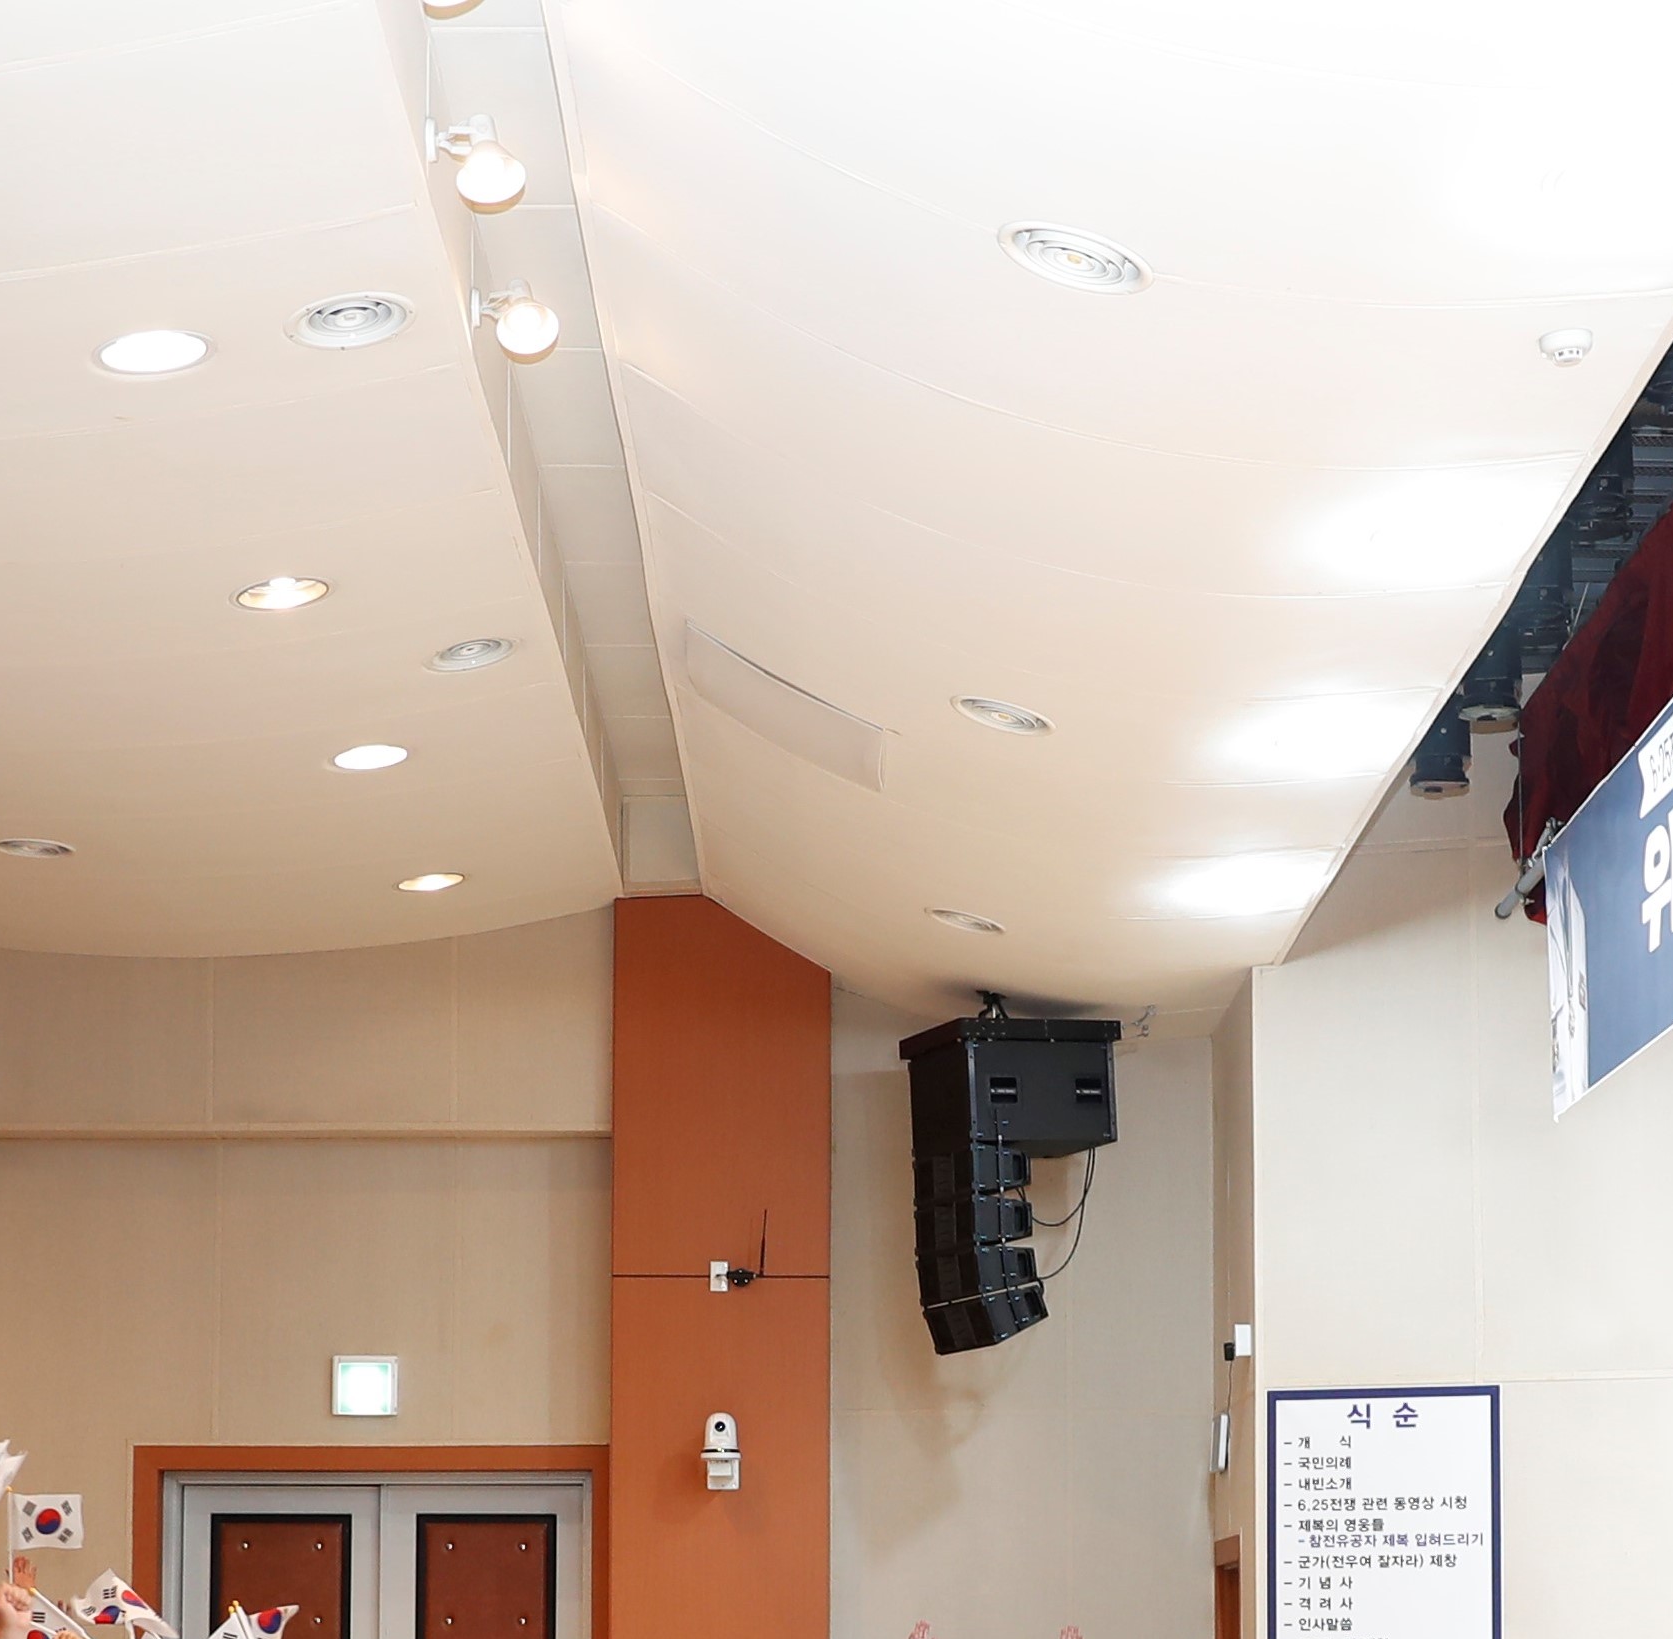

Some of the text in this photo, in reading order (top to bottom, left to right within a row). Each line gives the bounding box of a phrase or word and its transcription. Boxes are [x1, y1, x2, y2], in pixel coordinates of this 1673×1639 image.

[1298, 1457, 1351, 1470] 국민의례
[1299, 1477, 1351, 1490] 내빈소개
[1362, 1498, 1387, 1510] 관련
[1394, 1497, 1434, 1510] 동영상
[1441, 1496, 1466, 1509] 시청
[1299, 1518, 1384, 1532] 제복의 영웅들
[1309, 1533, 1483, 1548] 참전유공자 제복 입혀드리기
[1298, 1554, 1457, 1569] 군가(전우여 잘자라) 제창
[1299, 1618, 1352, 1631] 인사말씀
